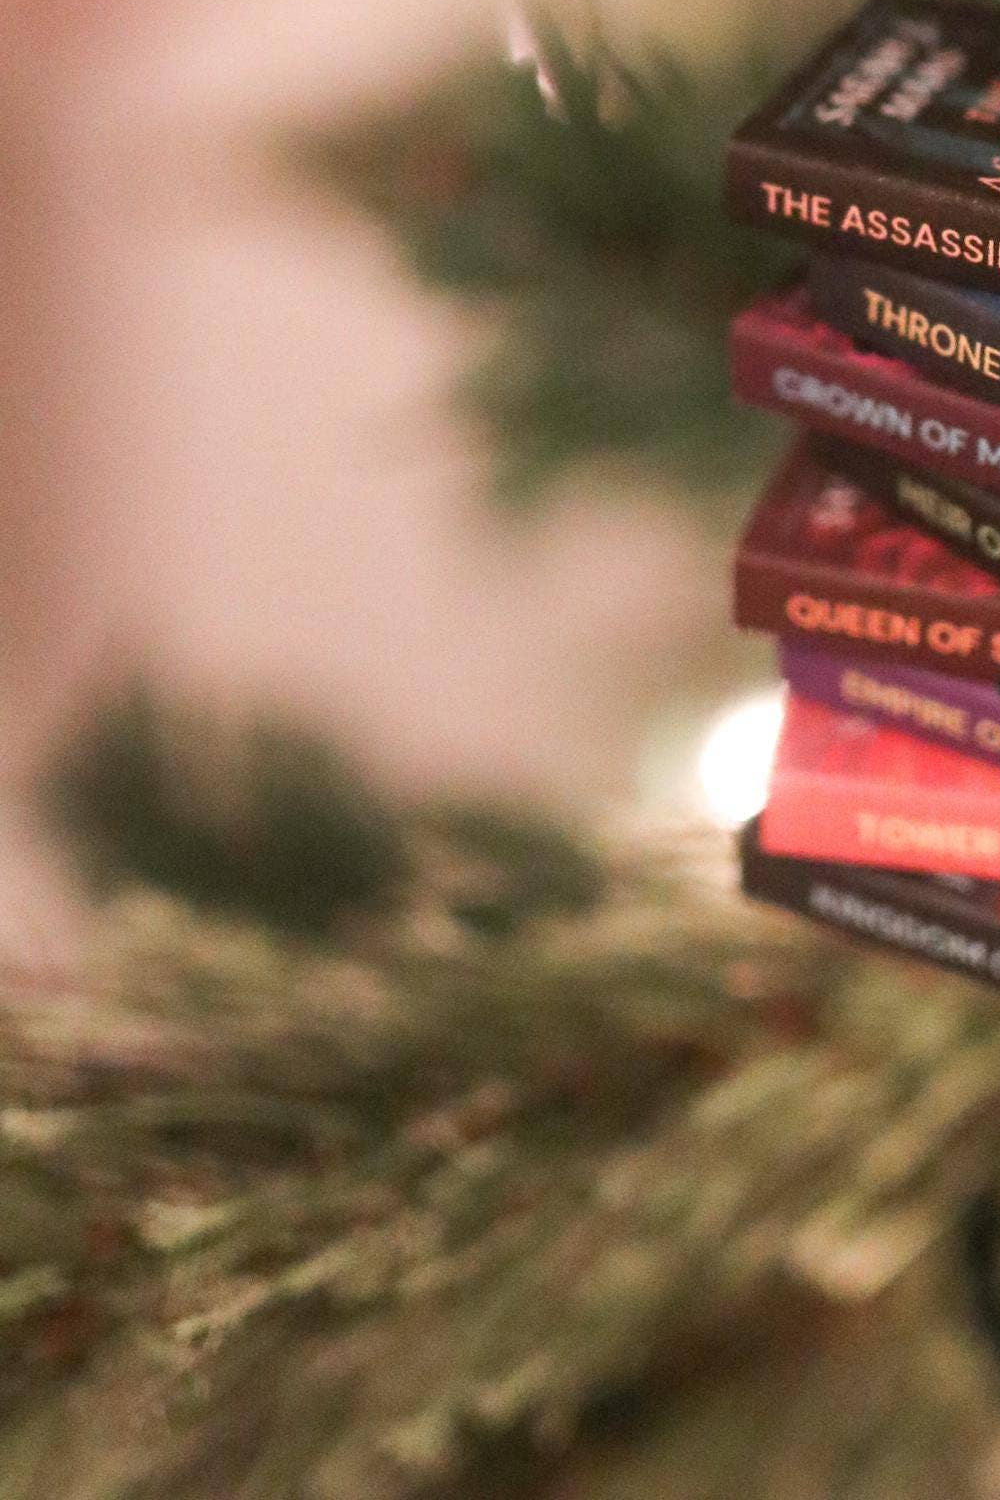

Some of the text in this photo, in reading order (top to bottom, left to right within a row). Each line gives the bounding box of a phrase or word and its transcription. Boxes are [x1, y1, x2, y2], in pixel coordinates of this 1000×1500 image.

[760, 182, 832, 228] THE
[772, 367, 913, 439] CROWN
[919, 418, 969, 454] OF
[786, 594, 921, 646] QUEEN
[926, 619, 983, 656] OF
